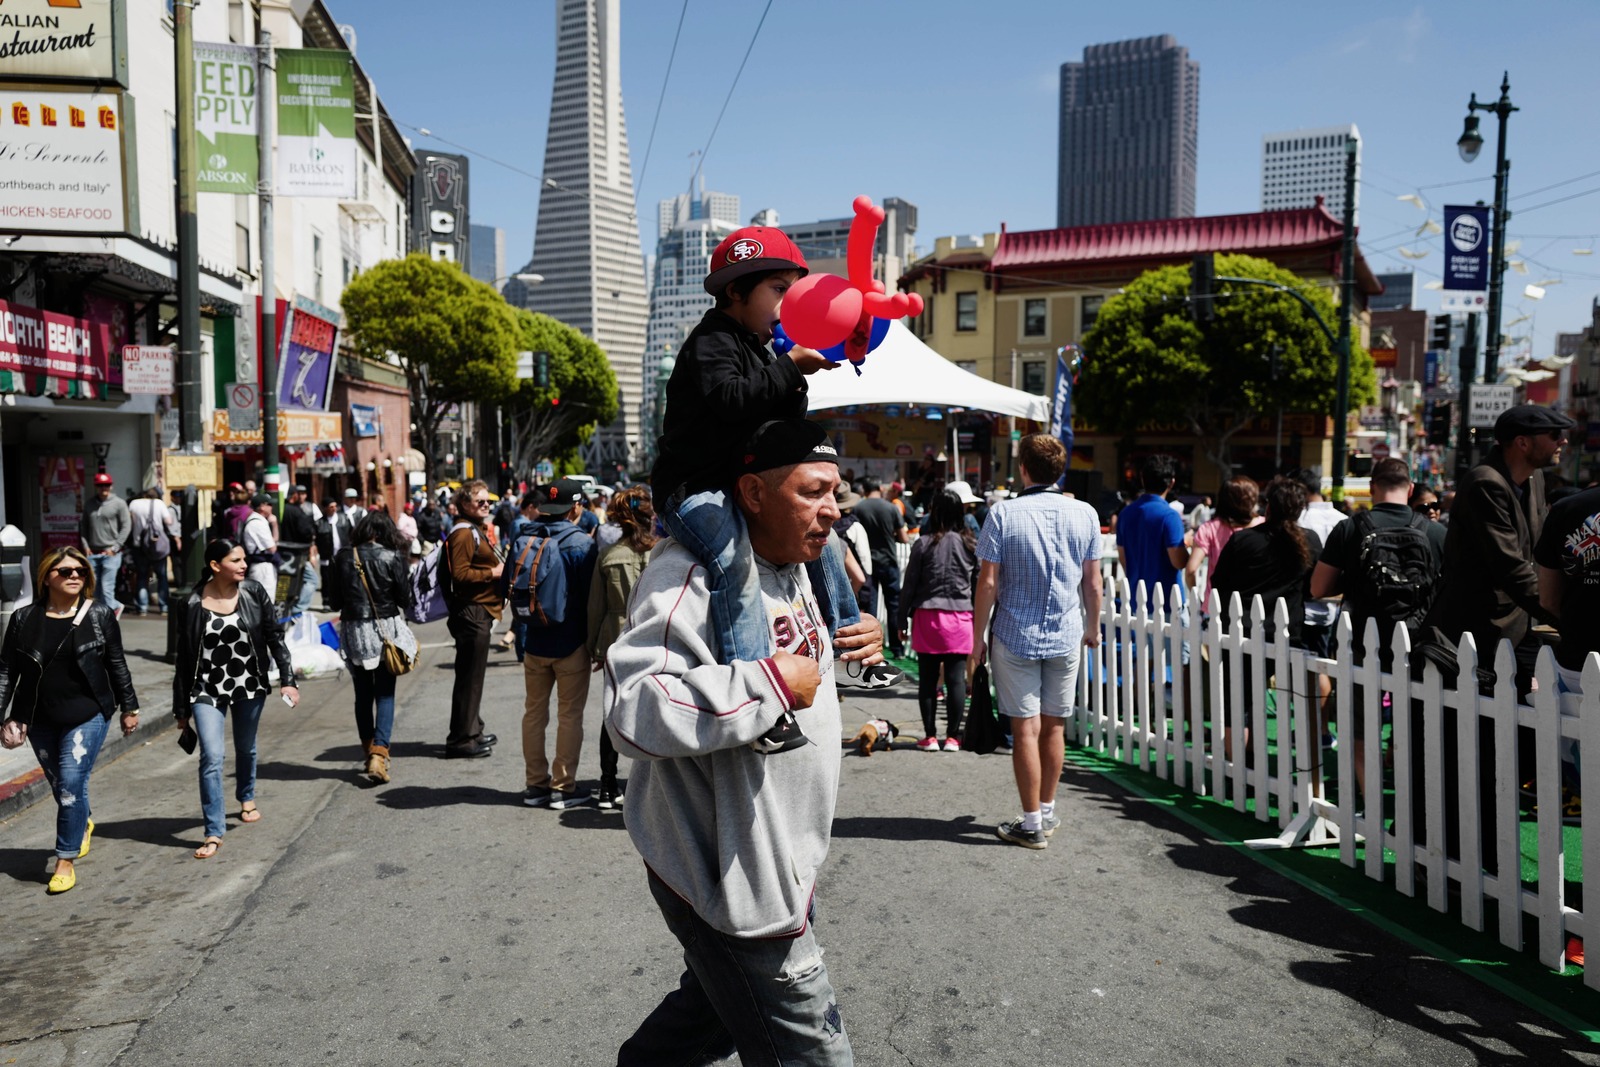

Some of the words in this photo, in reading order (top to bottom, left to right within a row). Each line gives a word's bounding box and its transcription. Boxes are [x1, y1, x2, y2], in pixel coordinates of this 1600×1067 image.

[193, 61, 256, 97] EED
[24, 142, 109, 164] Sorrento
[288, 163, 344, 175] BABSON
[59, 183, 80, 192] and
[48, 321, 91, 358] BEACH
[125, 347, 139, 361] NO
[141, 351, 174, 361] PARKING
[1475, 401, 1508, 411] MUST
